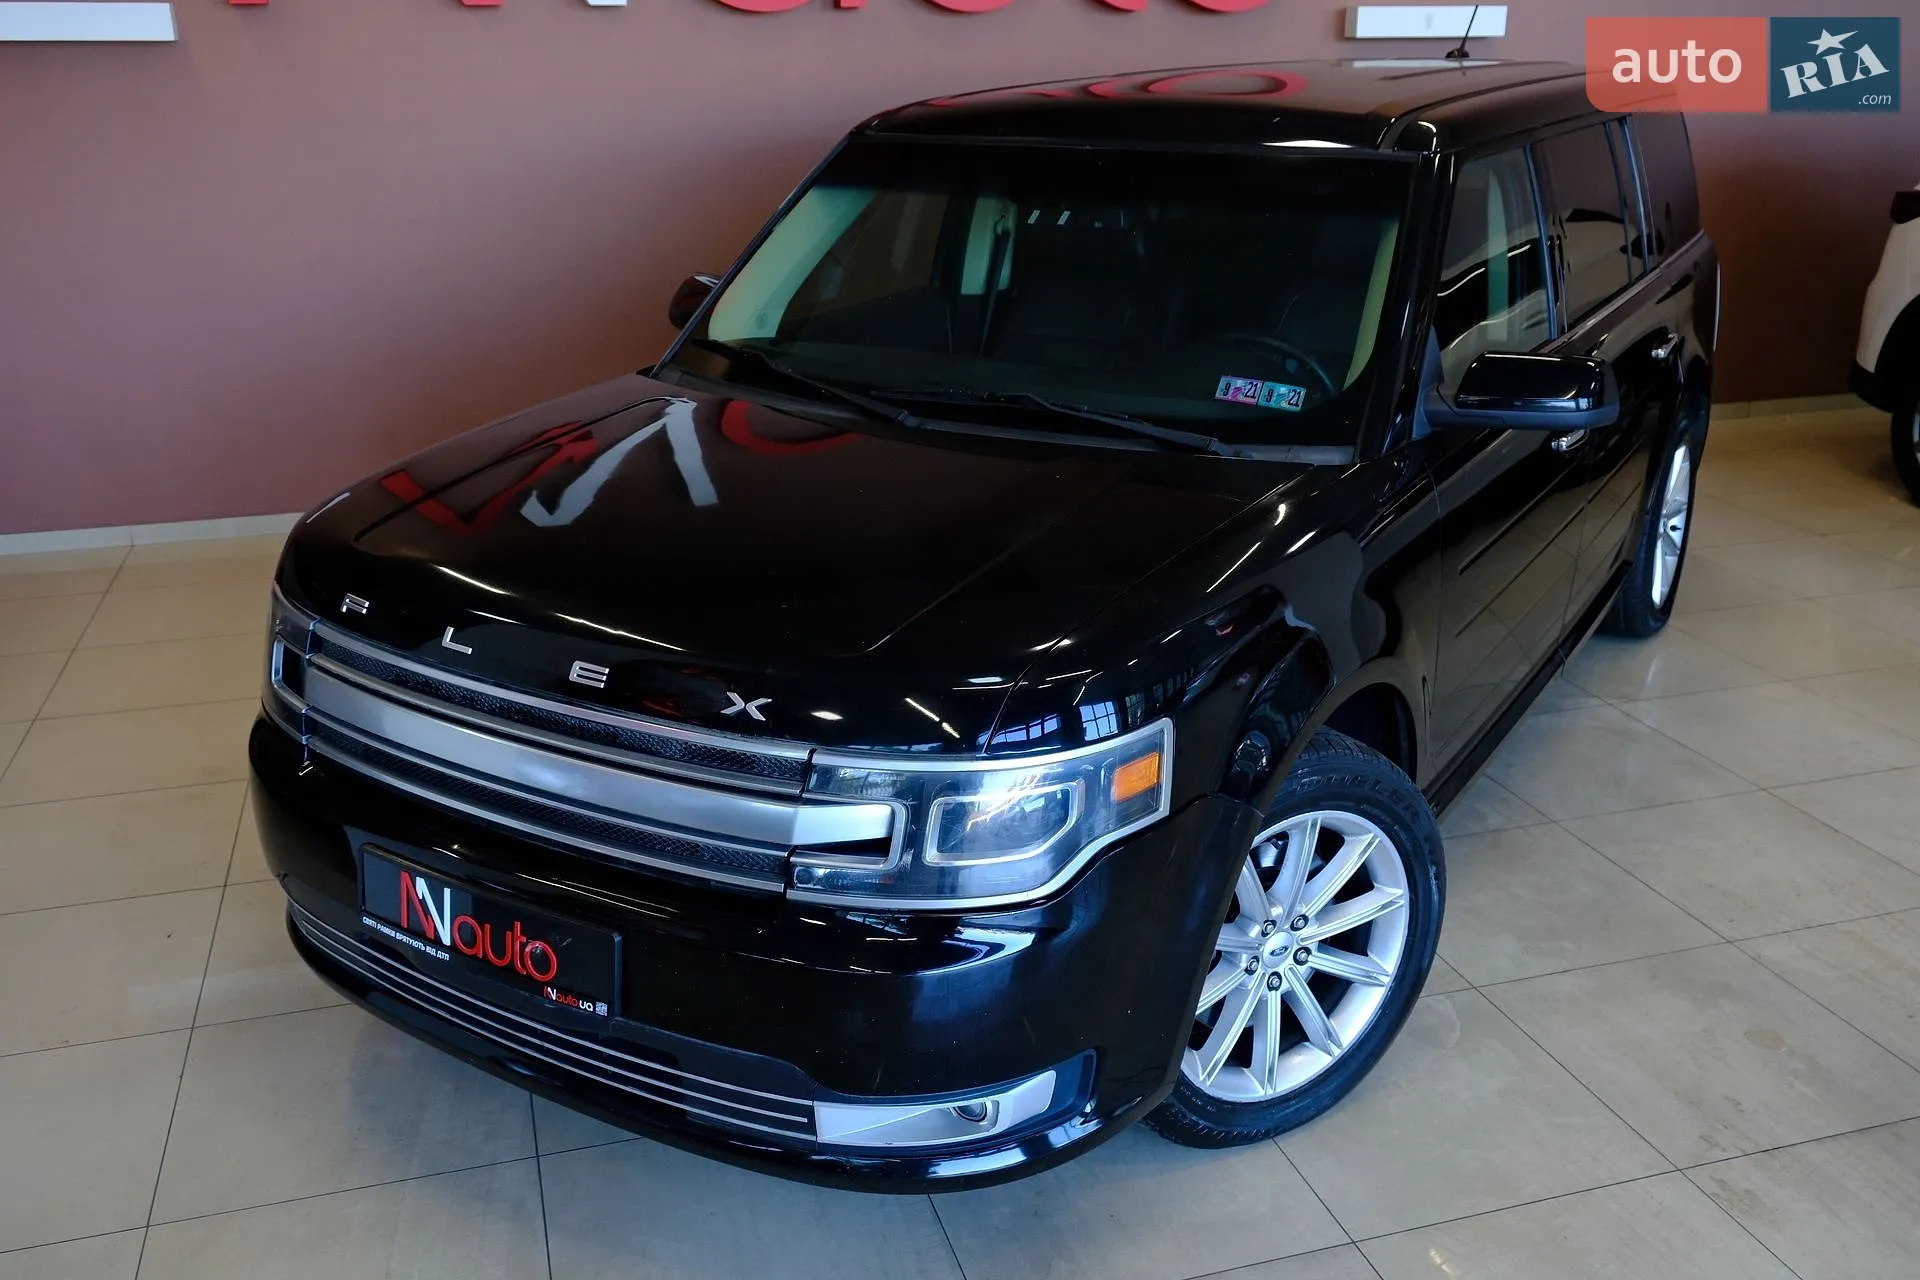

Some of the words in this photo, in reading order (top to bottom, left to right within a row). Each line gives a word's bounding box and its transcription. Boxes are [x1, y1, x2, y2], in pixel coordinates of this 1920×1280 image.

[1223, 382, 1231, 396] 9
[1244, 381, 1259, 399] 21
[1266, 388, 1274, 402] 9
[1288, 389, 1300, 407] 21
[340, 593, 773, 721] FLEX
